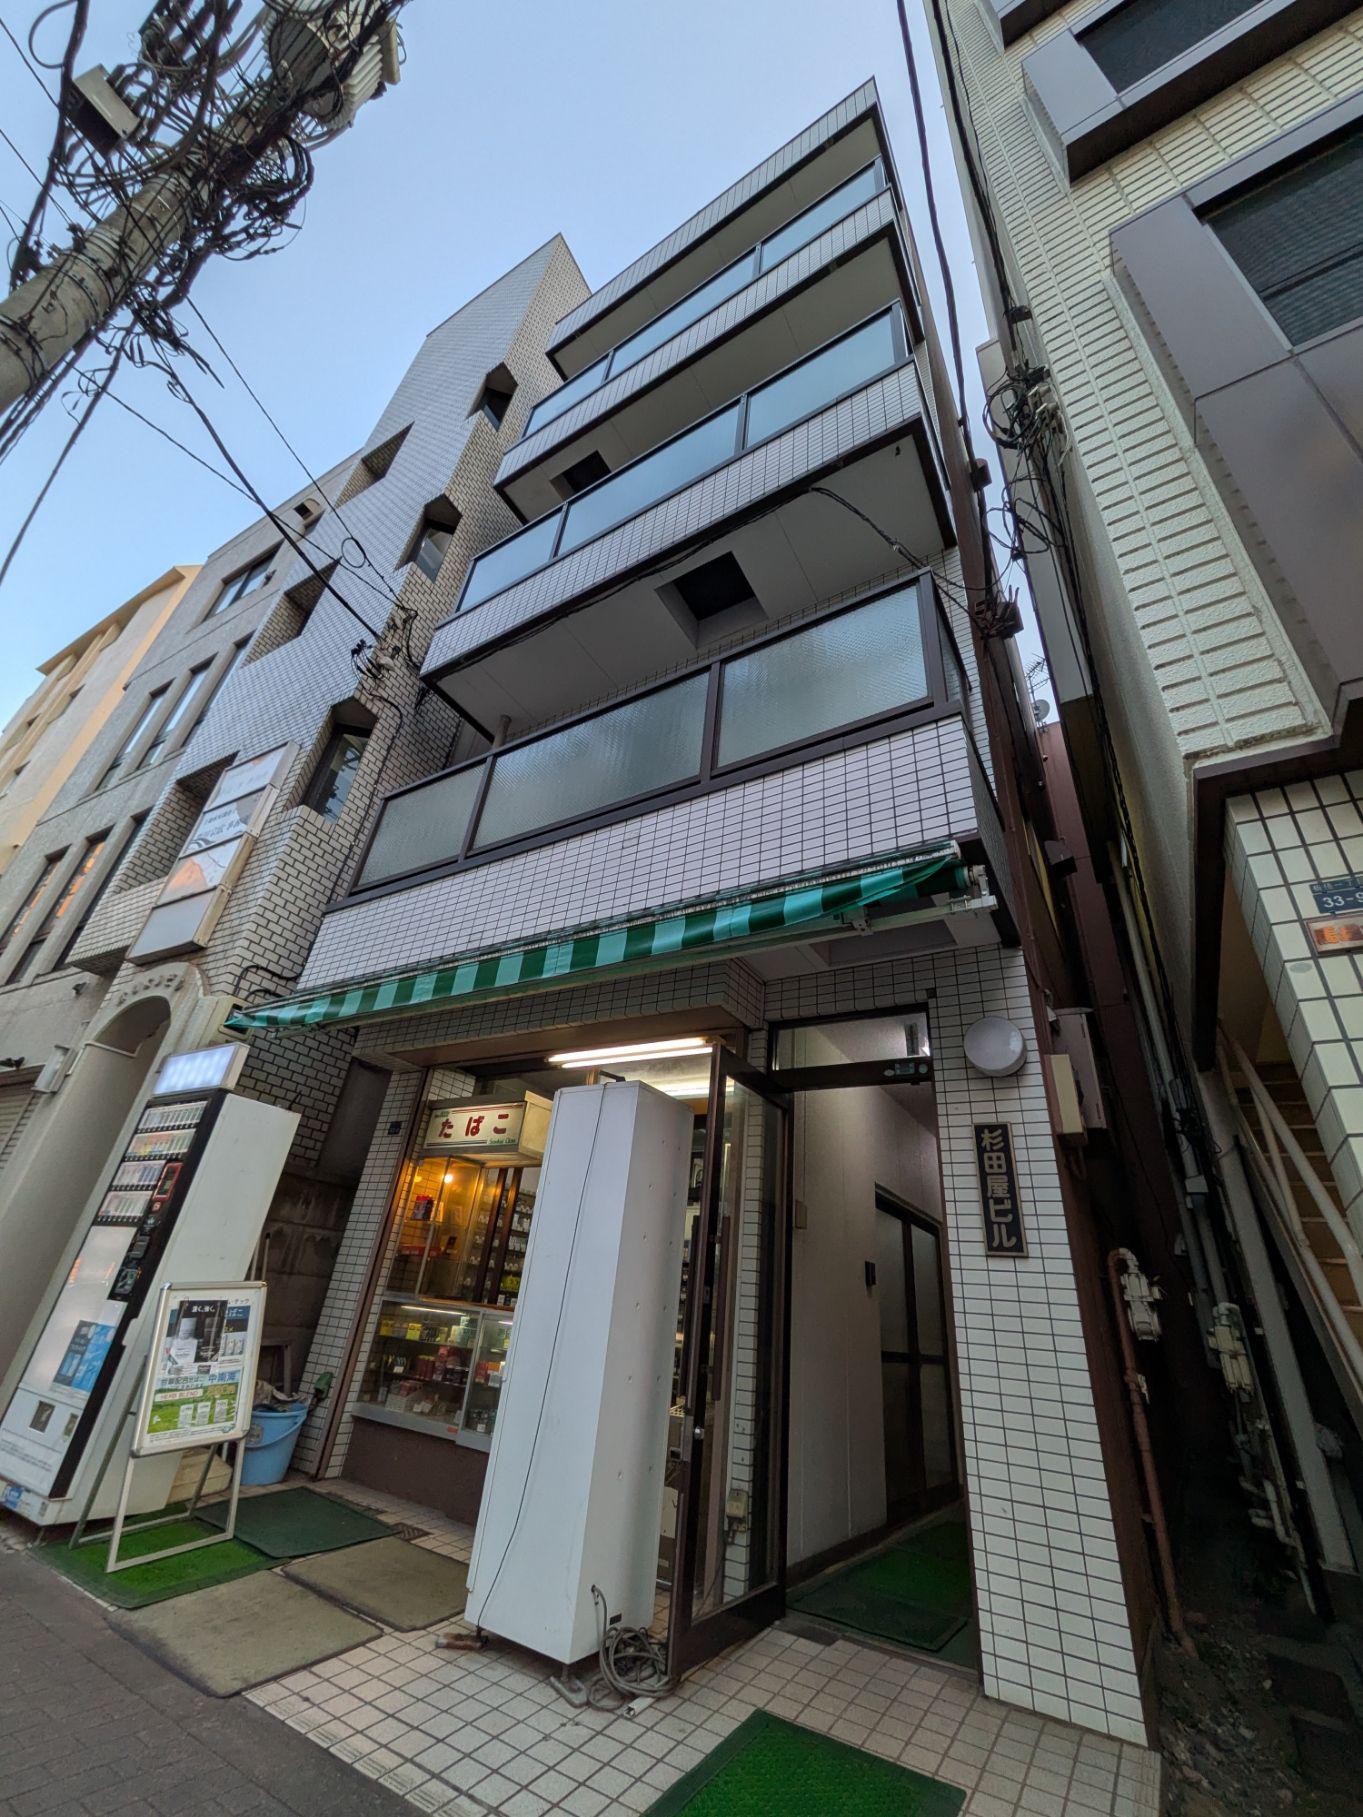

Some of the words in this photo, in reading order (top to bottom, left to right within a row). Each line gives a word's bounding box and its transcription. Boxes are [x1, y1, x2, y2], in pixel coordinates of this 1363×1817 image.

[438, 1113, 509, 1138] たばこ
[981, 1128, 1017, 1248] 杉田屋ビル
